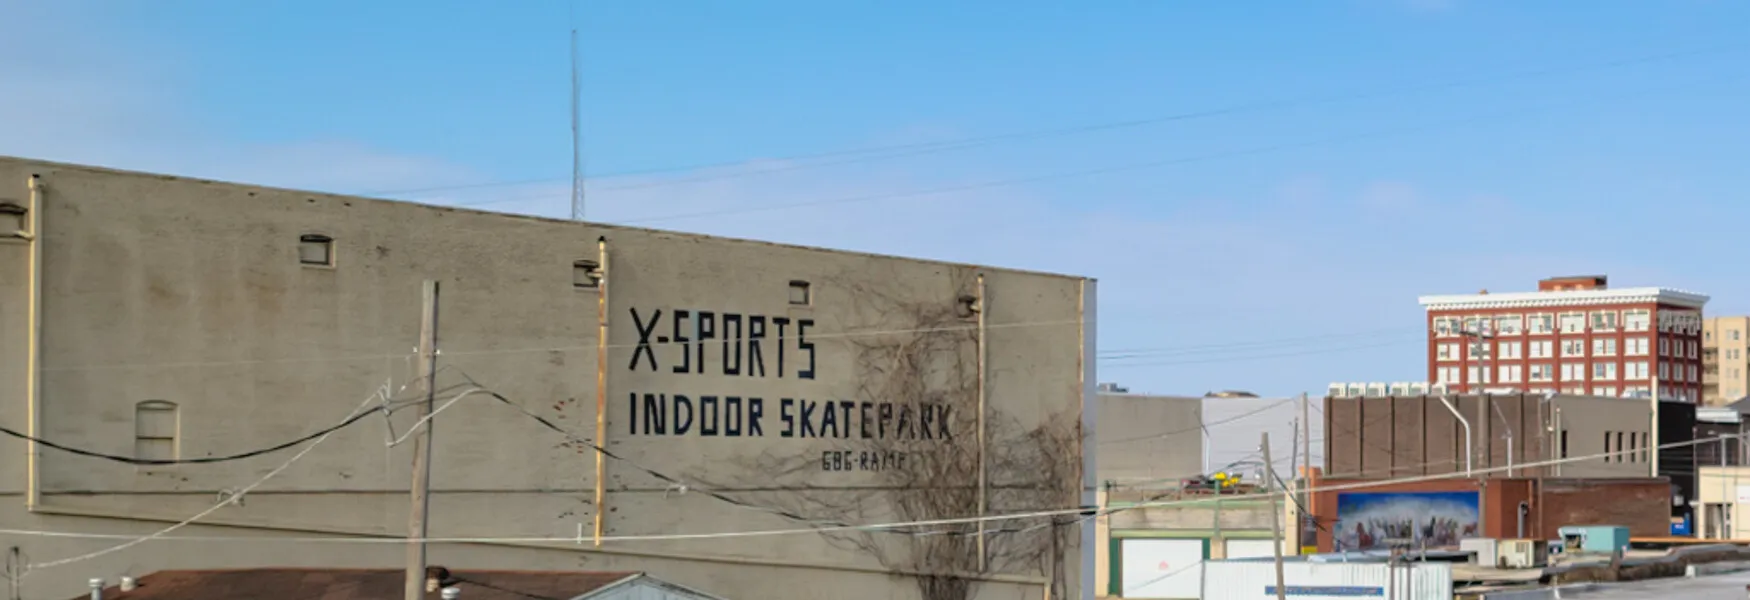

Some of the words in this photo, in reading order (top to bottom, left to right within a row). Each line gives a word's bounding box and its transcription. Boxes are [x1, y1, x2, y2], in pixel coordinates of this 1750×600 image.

[628, 306, 815, 379] X-SPORTS
[630, 392, 763, 437] INDOOR
[780, 398, 953, 440] SKATEPARK
